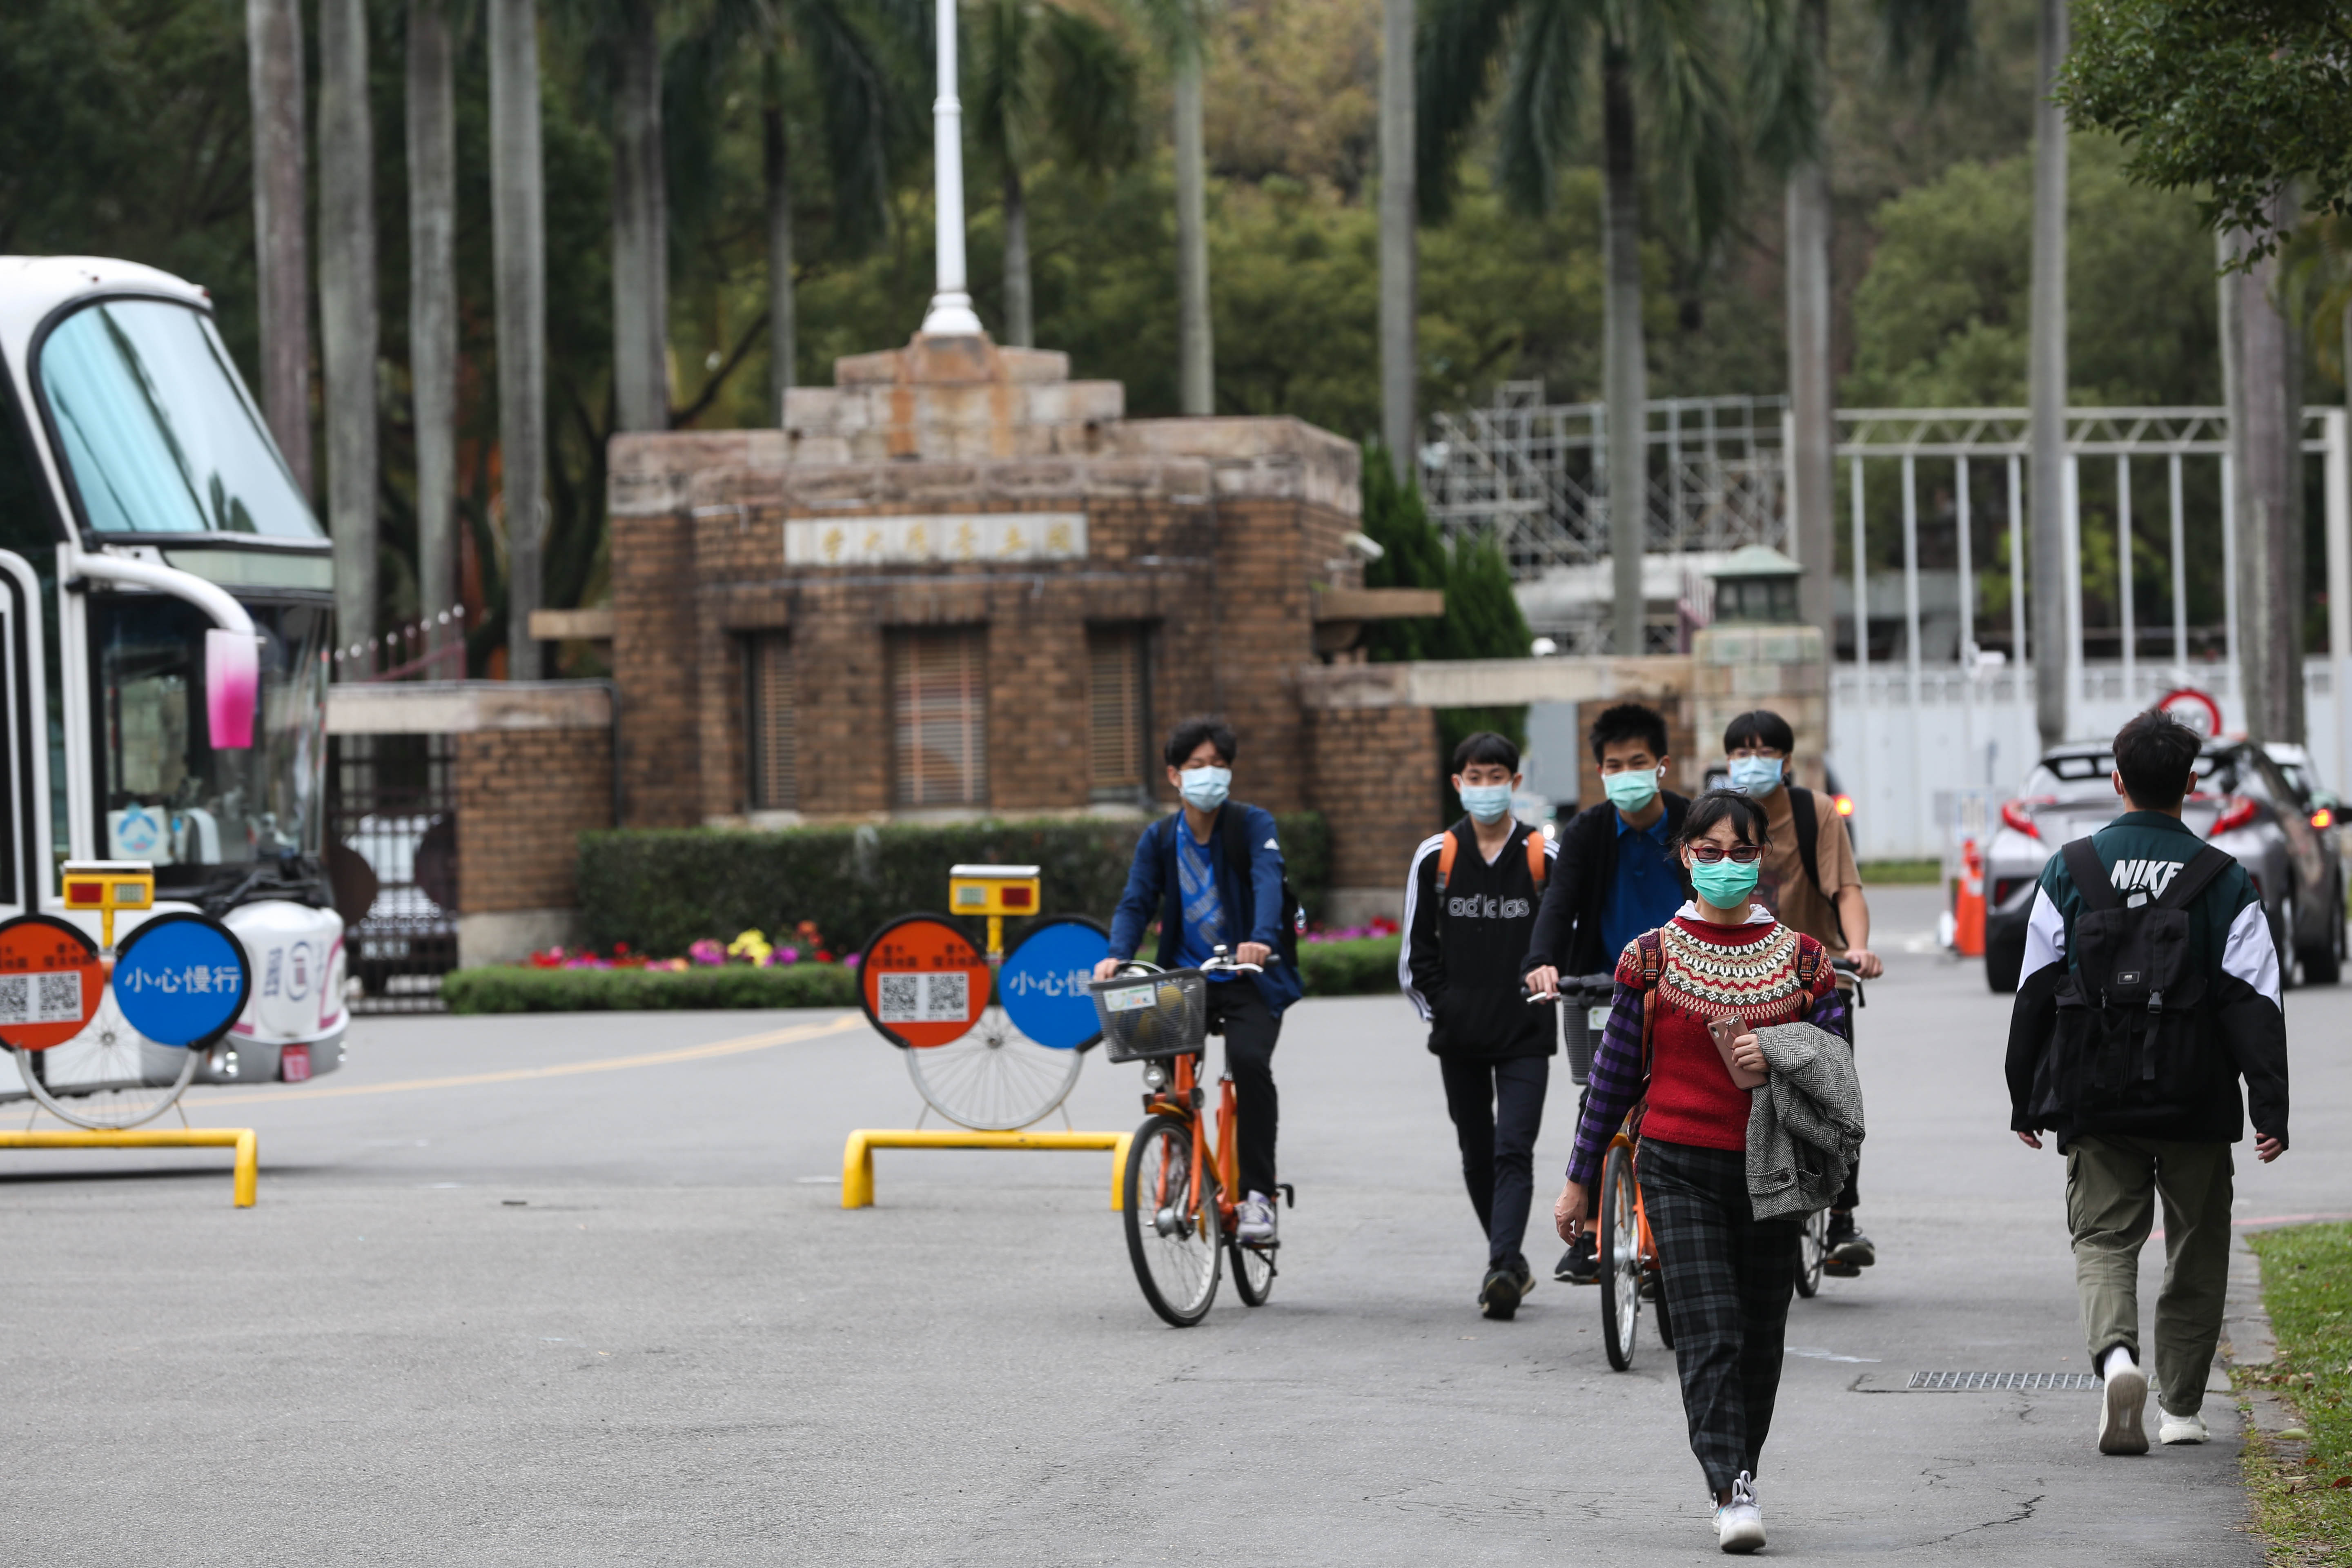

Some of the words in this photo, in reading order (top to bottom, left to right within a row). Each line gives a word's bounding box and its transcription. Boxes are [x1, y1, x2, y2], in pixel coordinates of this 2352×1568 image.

[1448, 893, 1530, 919] adidas
[124, 964, 241, 994] 小心慢行
